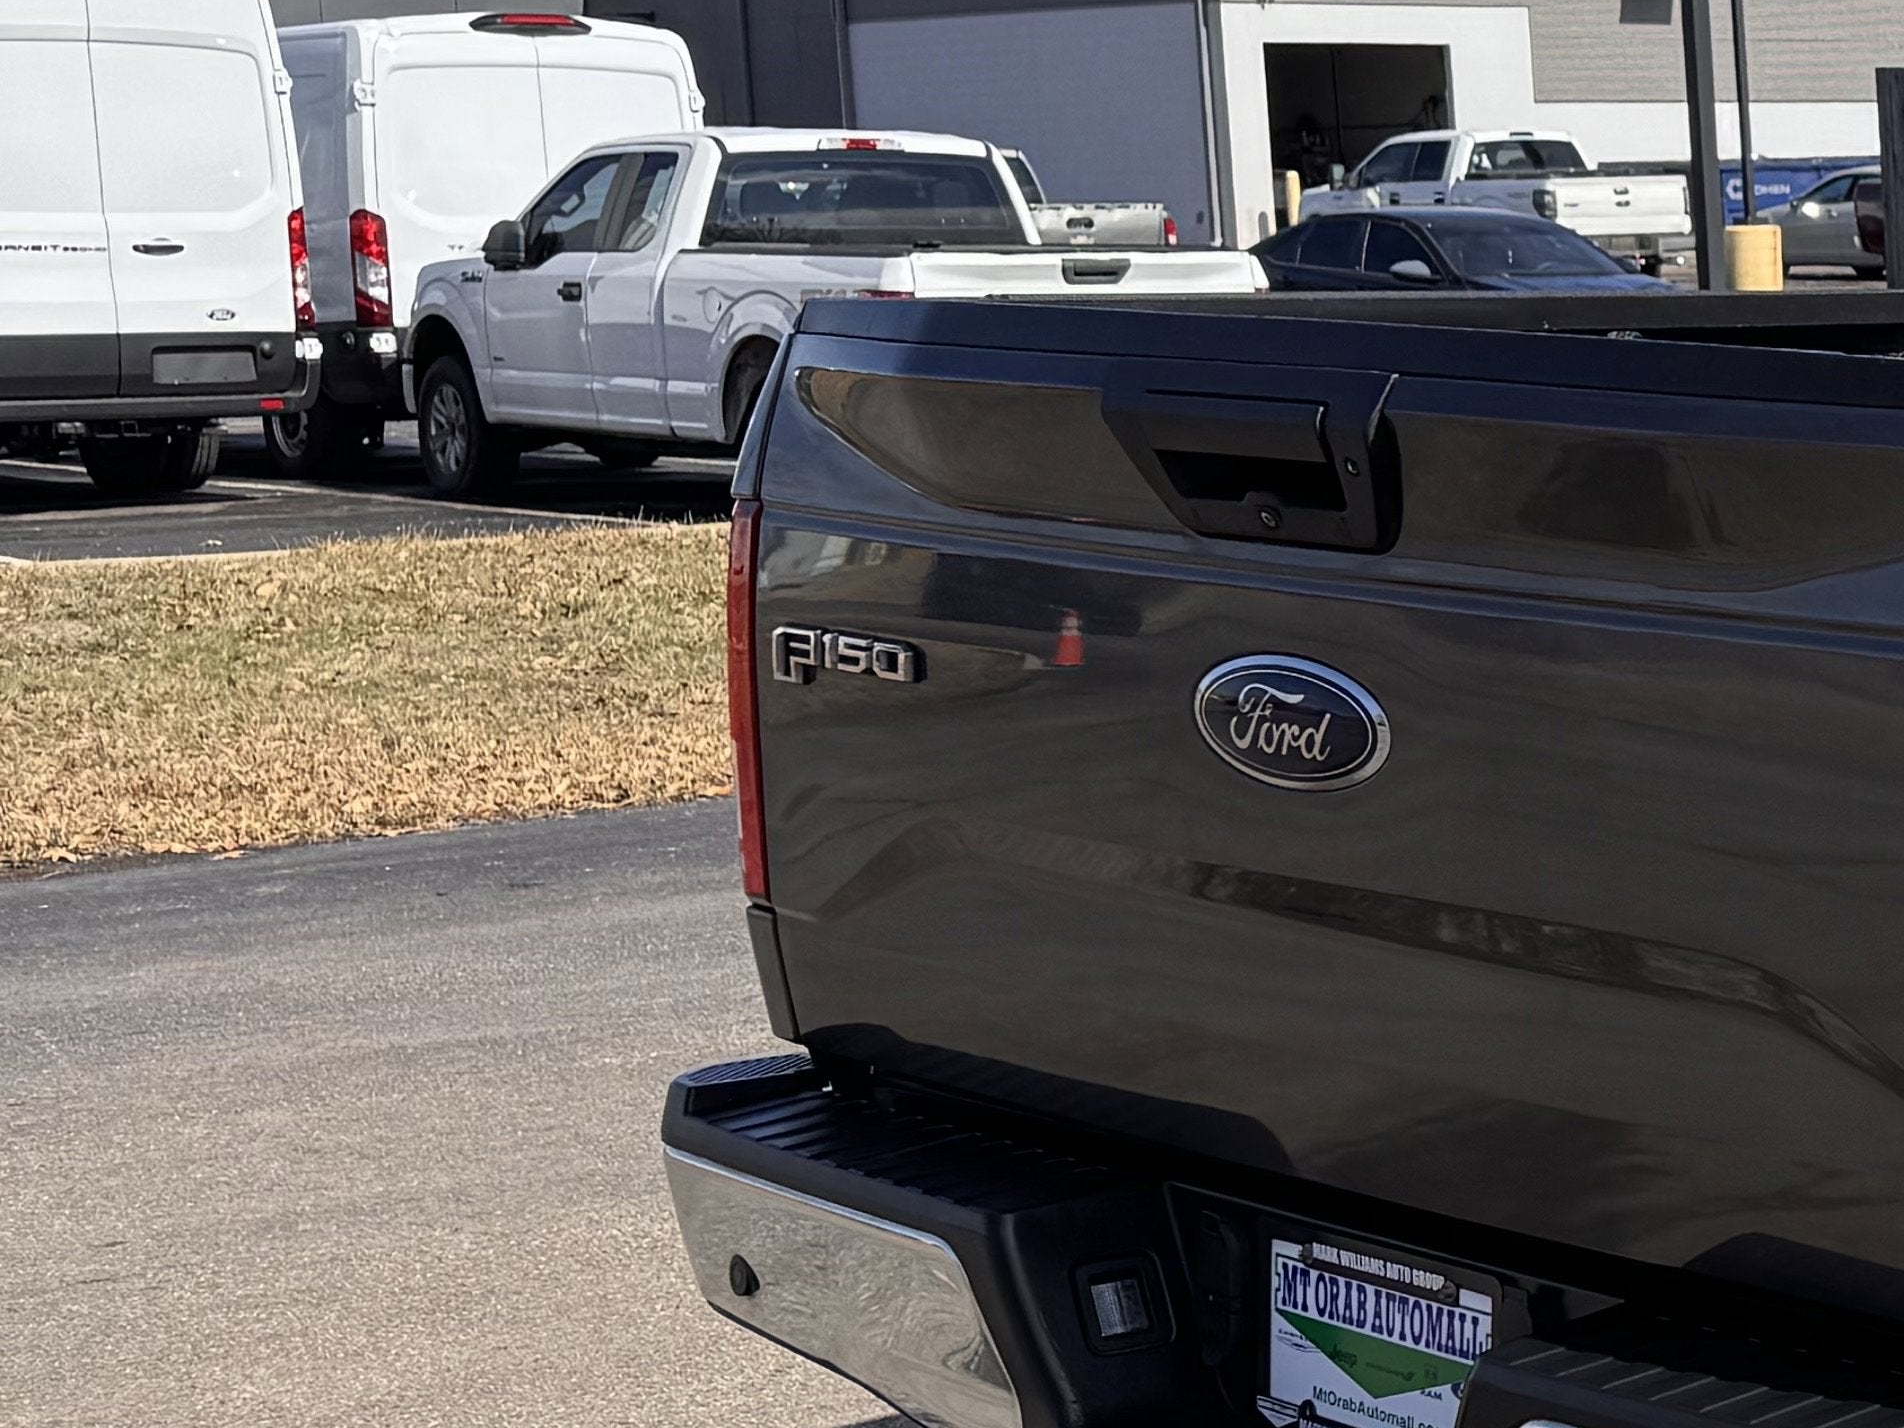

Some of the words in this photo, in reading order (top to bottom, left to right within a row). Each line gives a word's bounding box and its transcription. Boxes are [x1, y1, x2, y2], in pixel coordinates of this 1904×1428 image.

[1230, 682, 1332, 762] Ford
[1312, 1242, 1340, 1265] MARK
[1340, 1250, 1386, 1277] WILLIAMS
[1386, 1261, 1412, 1284] AUTO
[1412, 1268, 1446, 1291] GROUP
[1281, 1261, 1311, 1313] MT
[1315, 1272, 1368, 1330] ORAB
[1371, 1289, 1484, 1362] AUTOMALL
